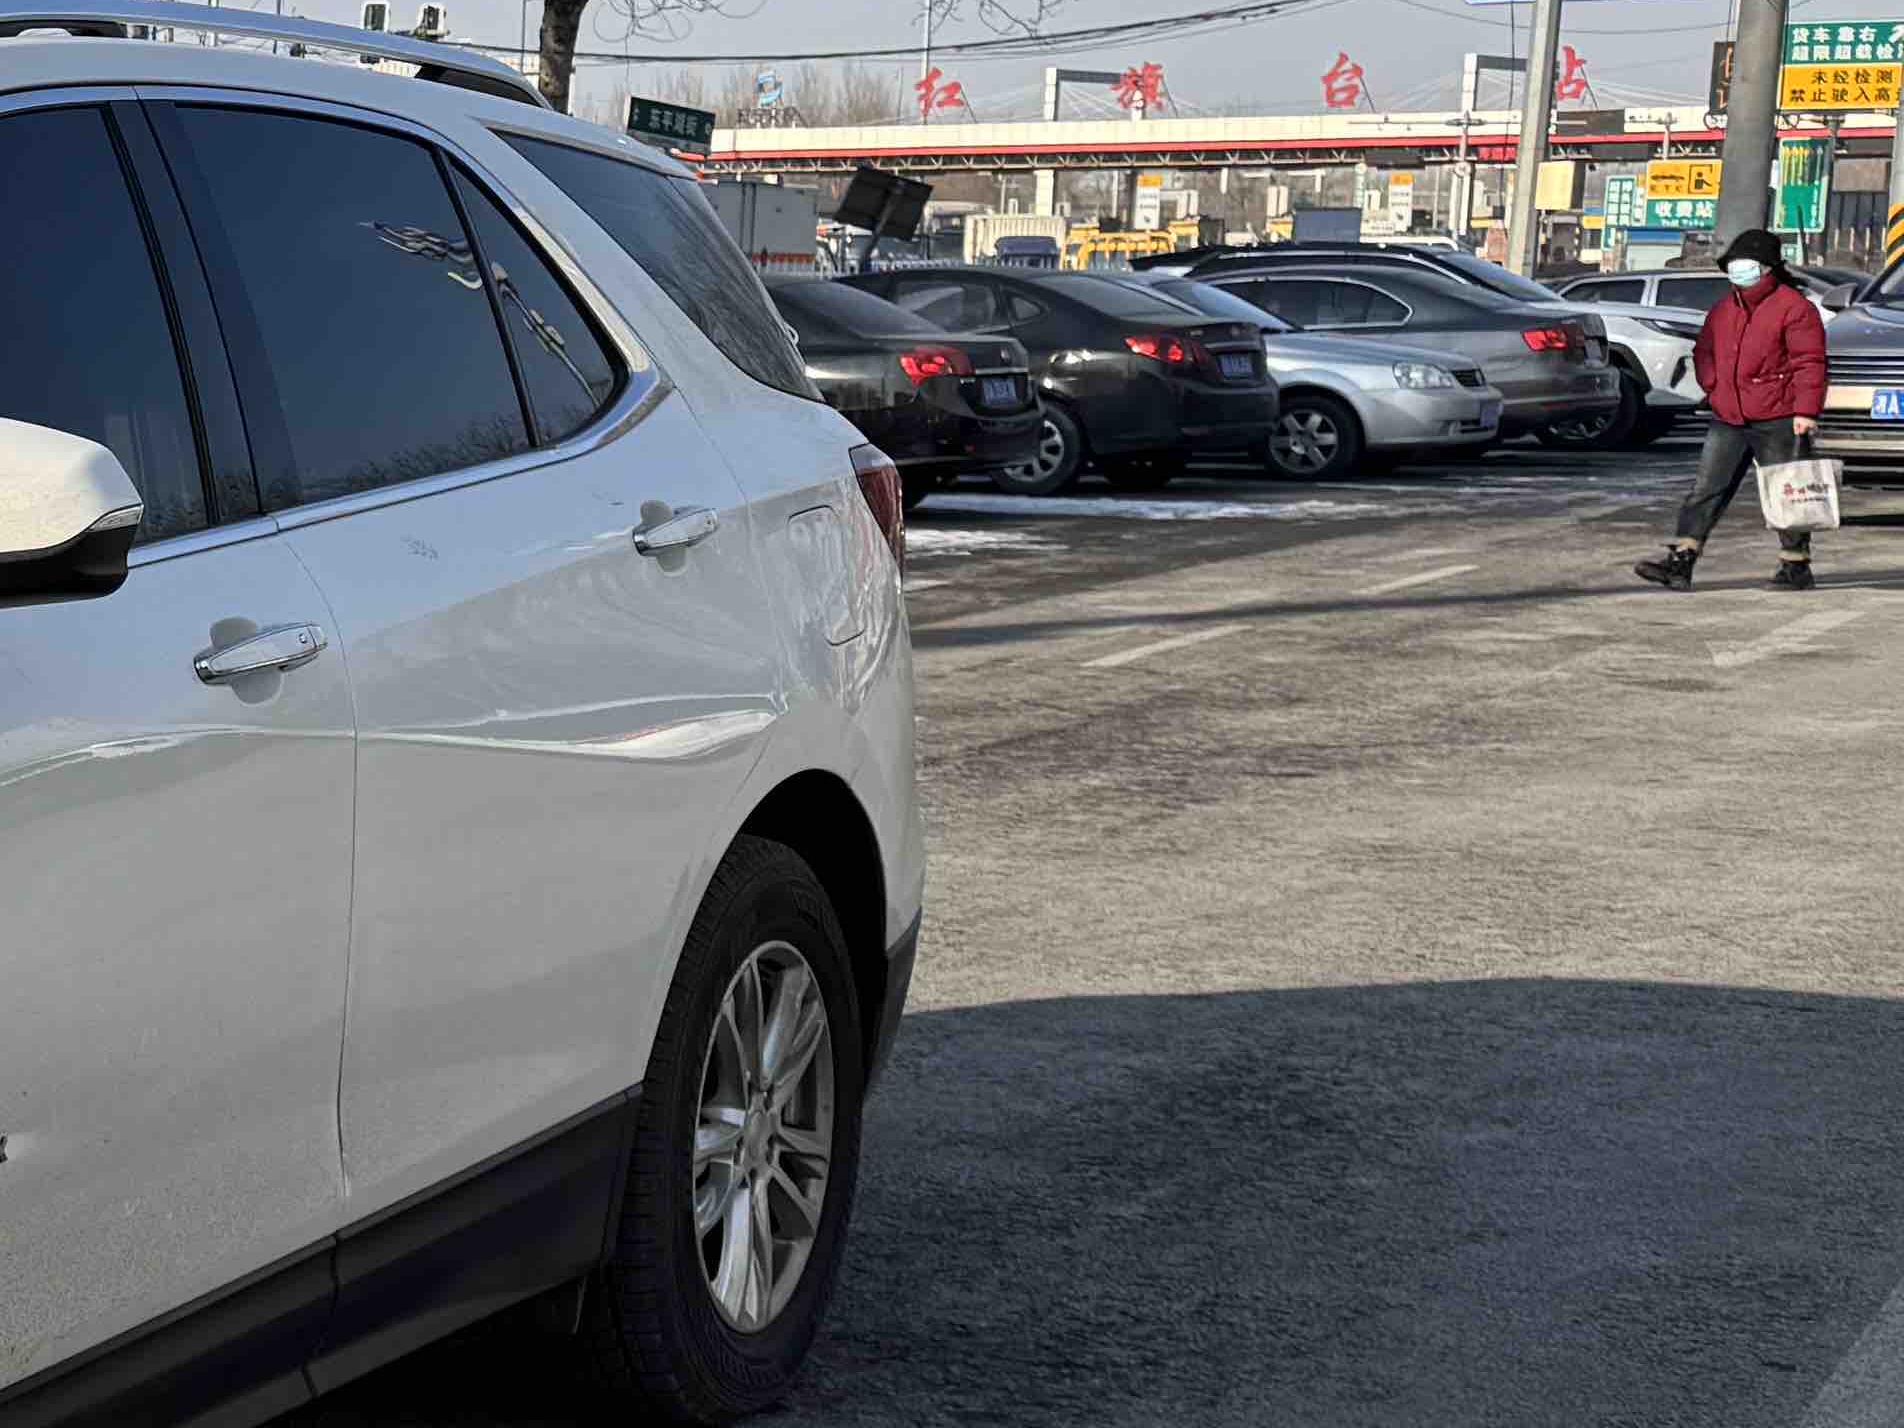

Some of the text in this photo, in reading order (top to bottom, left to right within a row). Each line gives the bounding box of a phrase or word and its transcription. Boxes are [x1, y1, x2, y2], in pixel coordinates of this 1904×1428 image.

[1811, 69, 1894, 85] 未经检测
[1790, 87, 1902, 103] 禁止驶入高
